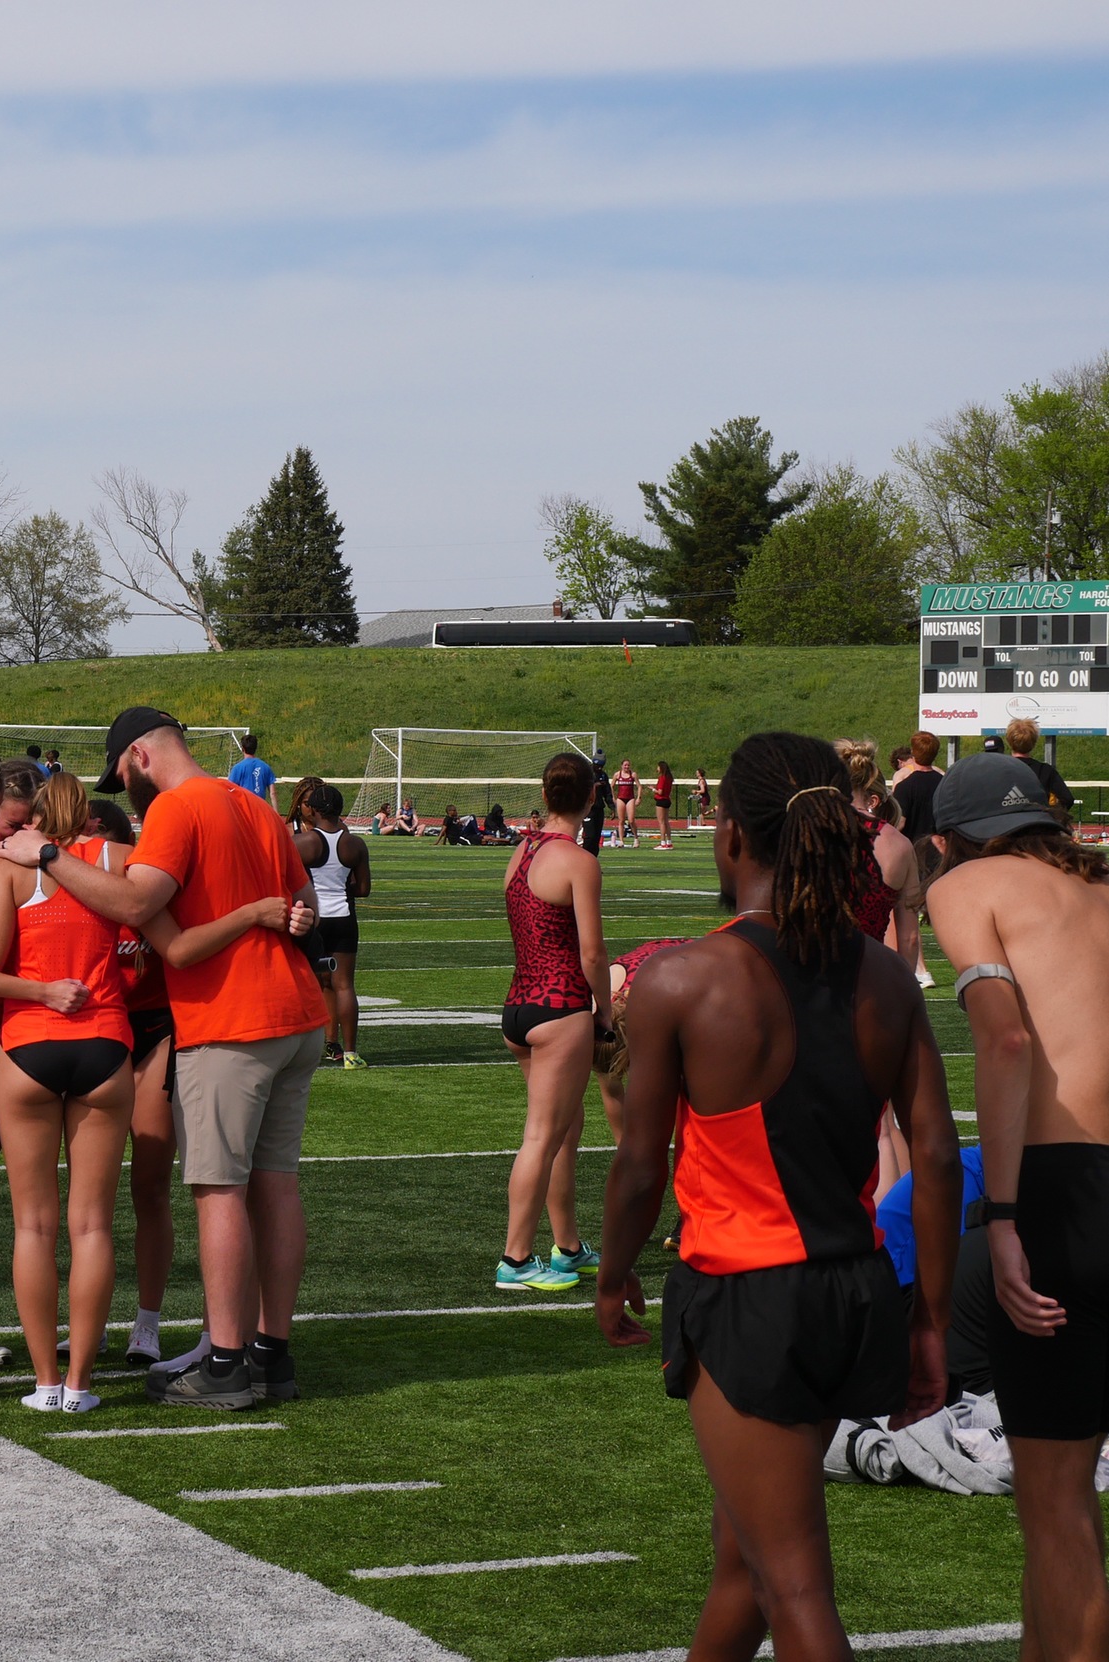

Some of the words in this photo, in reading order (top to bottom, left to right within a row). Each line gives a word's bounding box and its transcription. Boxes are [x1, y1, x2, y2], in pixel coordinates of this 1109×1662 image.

[928, 584, 1074, 612] MUSTANGS
[923, 621, 981, 636] MUSTANGS
[995, 652, 1011, 662] TOL
[1079, 651, 1096, 661] TOL
[938, 671, 978, 688] DOWN
[1015, 670, 1034, 687] TO
[1039, 670, 1059, 687] GO
[1069, 670, 1089, 687] ON
[1002, 798, 1029, 806] adidas
